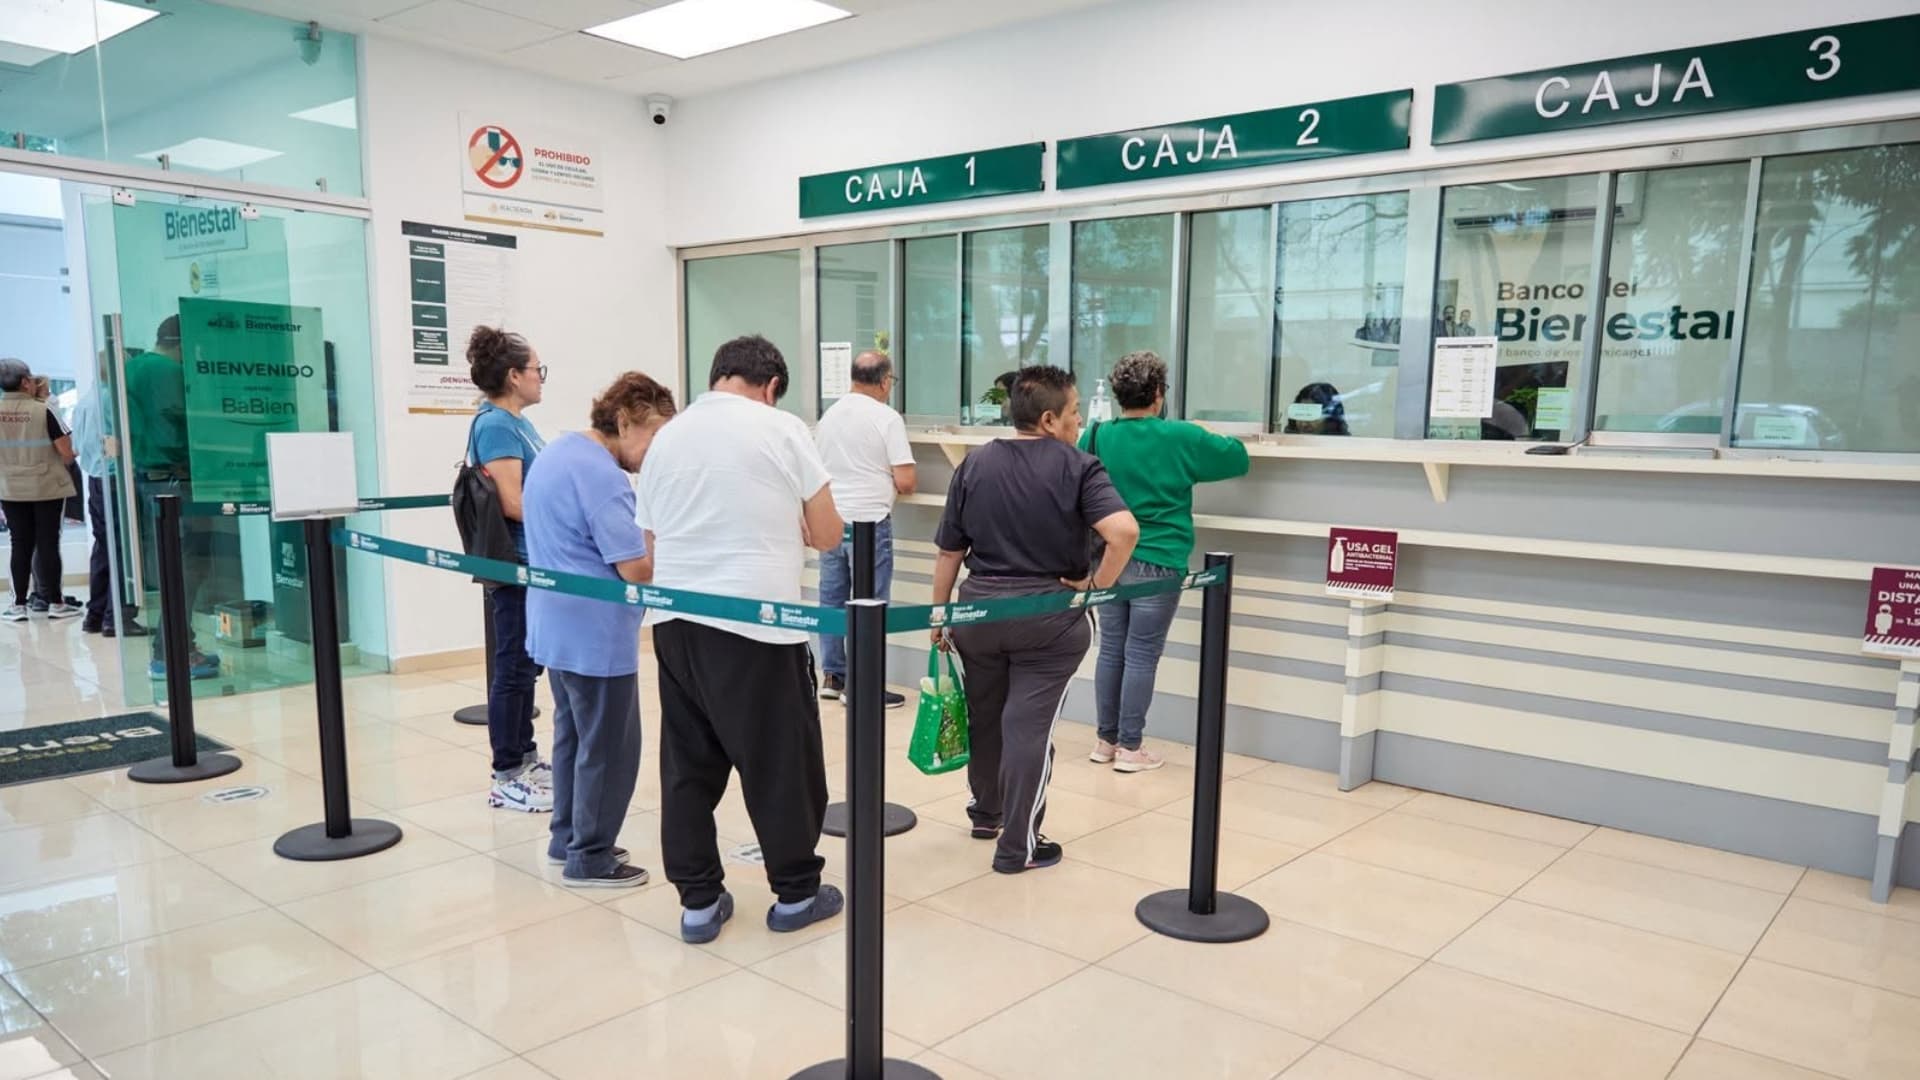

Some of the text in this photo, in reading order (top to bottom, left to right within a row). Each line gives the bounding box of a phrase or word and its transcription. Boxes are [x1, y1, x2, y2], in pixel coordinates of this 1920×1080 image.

[1534, 35, 1842, 119] CAJA 3
[1121, 108, 1321, 171] CAJA 2
[534, 147, 591, 166] PROHIBIDO
[845, 156, 976, 203] CAJA 1
[165, 205, 237, 241] Bienestar
[1497, 282, 1585, 301] Banco
[245, 319, 302, 333] Bienestar
[196, 361, 314, 379] BIENVENIDO
[222, 397, 297, 415] BaBien
[1346, 542, 1395, 555] USA GEL
[1346, 552, 1394, 562] ANTIBACTERIAL
[1898, 581, 1920, 591] UNA
[781, 612, 819, 626] Bienestar
